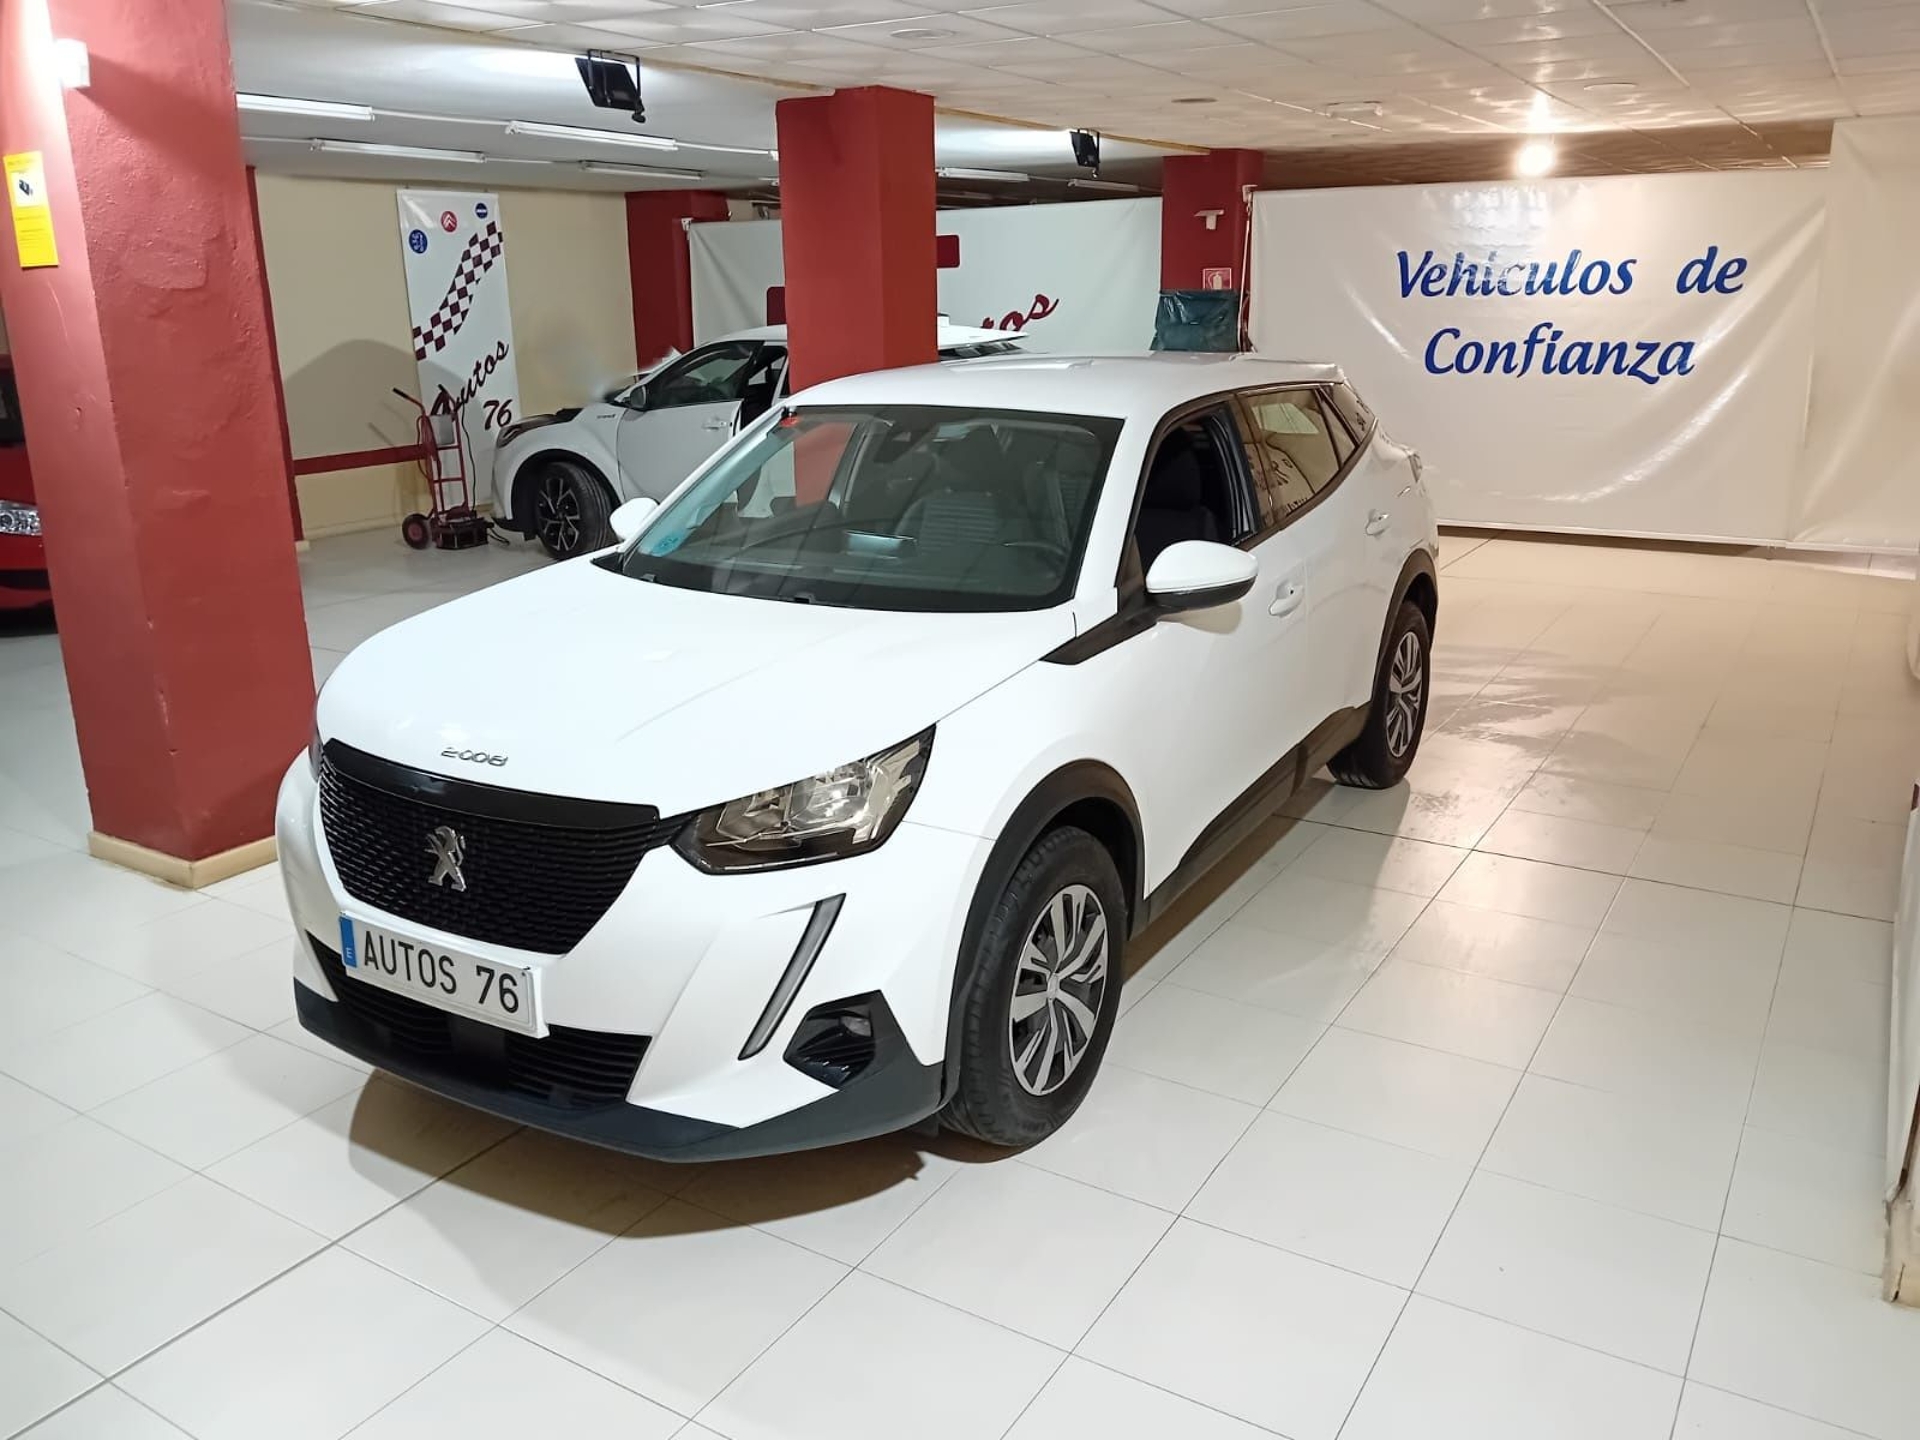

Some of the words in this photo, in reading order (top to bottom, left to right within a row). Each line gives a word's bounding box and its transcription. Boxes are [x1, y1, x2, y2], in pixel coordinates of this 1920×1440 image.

[1676, 245, 1748, 294] de
[1424, 322, 1696, 385] Confianza
[483, 399, 513, 431] 76
[441, 747, 508, 766] 2008
[364, 930, 457, 995] AUTOS
[475, 965, 519, 1014] 76
